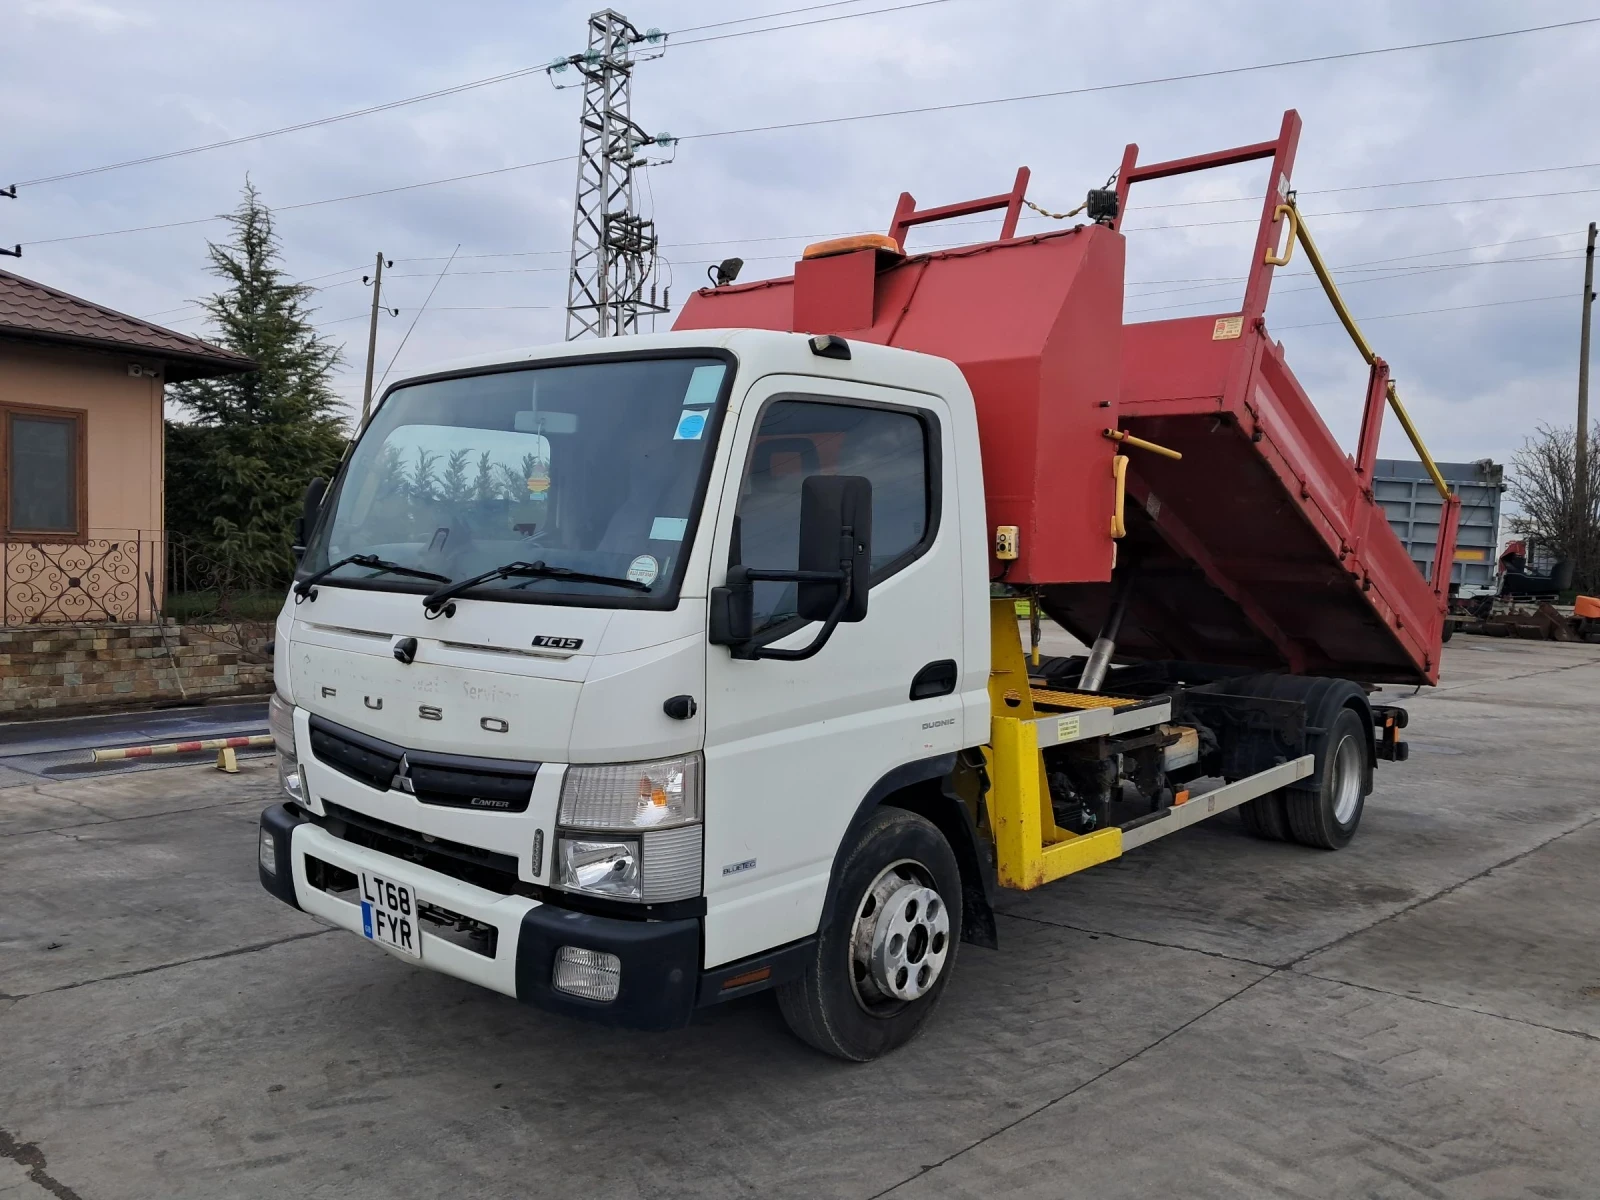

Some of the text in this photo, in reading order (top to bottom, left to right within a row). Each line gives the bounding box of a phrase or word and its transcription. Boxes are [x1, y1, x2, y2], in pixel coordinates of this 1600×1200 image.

[540, 636, 578, 648] 7C15
[321, 686, 509, 733] FUSO
[921, 718, 956, 731] DUONIC
[361, 872, 411, 916] LT68
[375, 908, 413, 950] FYR
